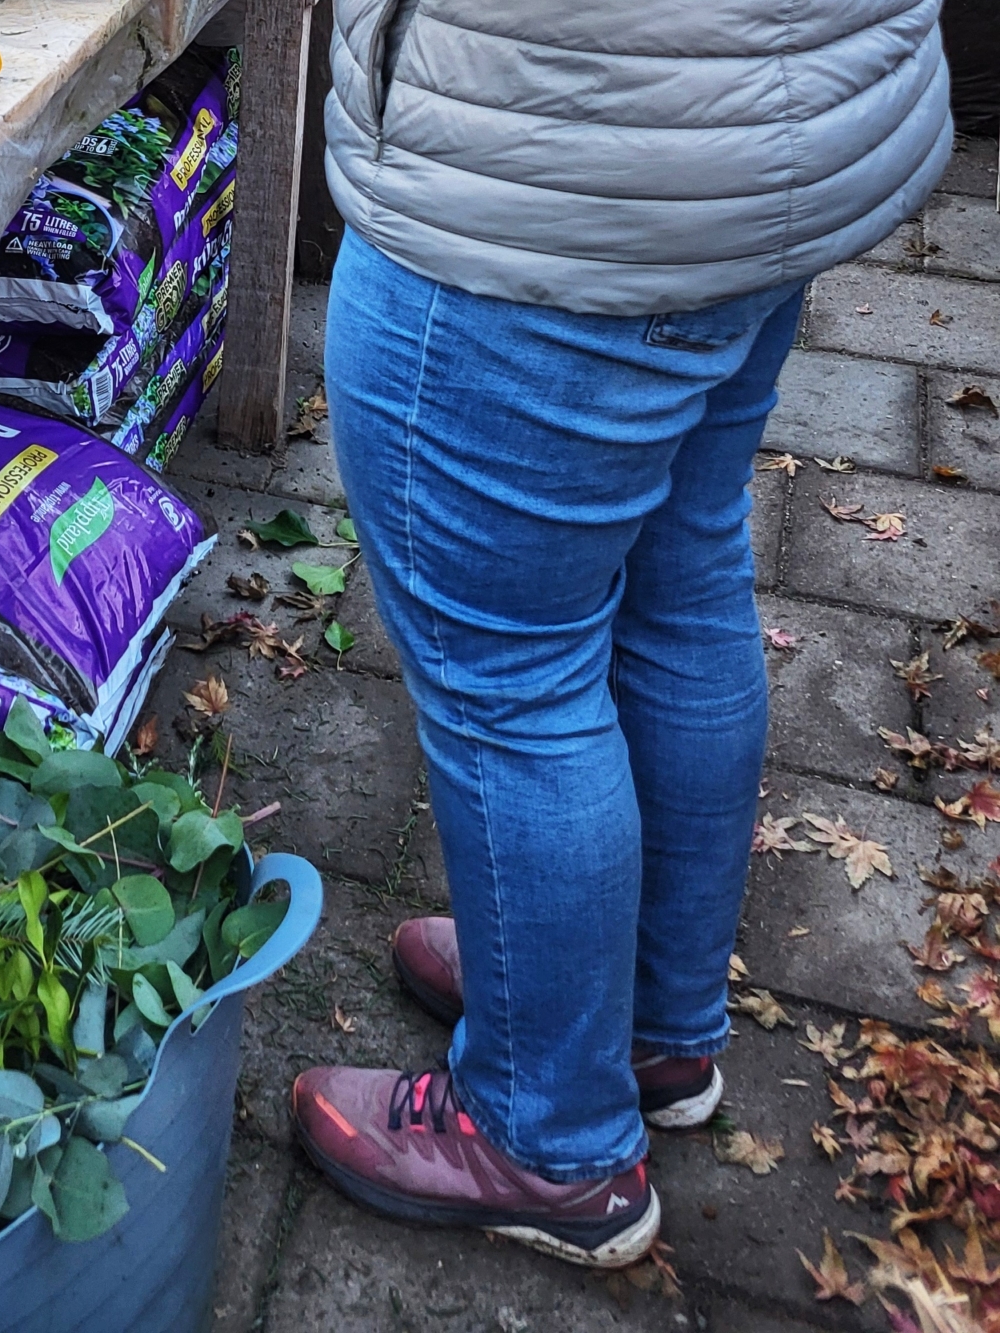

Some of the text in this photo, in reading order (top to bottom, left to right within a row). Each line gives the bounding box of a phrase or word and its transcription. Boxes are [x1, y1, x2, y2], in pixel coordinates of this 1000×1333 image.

[95, 139, 109, 153] 6
[21, 210, 79, 232] 75 LITRES
[43, 226, 60, 235] WHEN
[28, 240, 74, 250] HEAVY LOAD
[156, 262, 186, 303] PREMIER
[56, 496, 111, 557] Tippland
